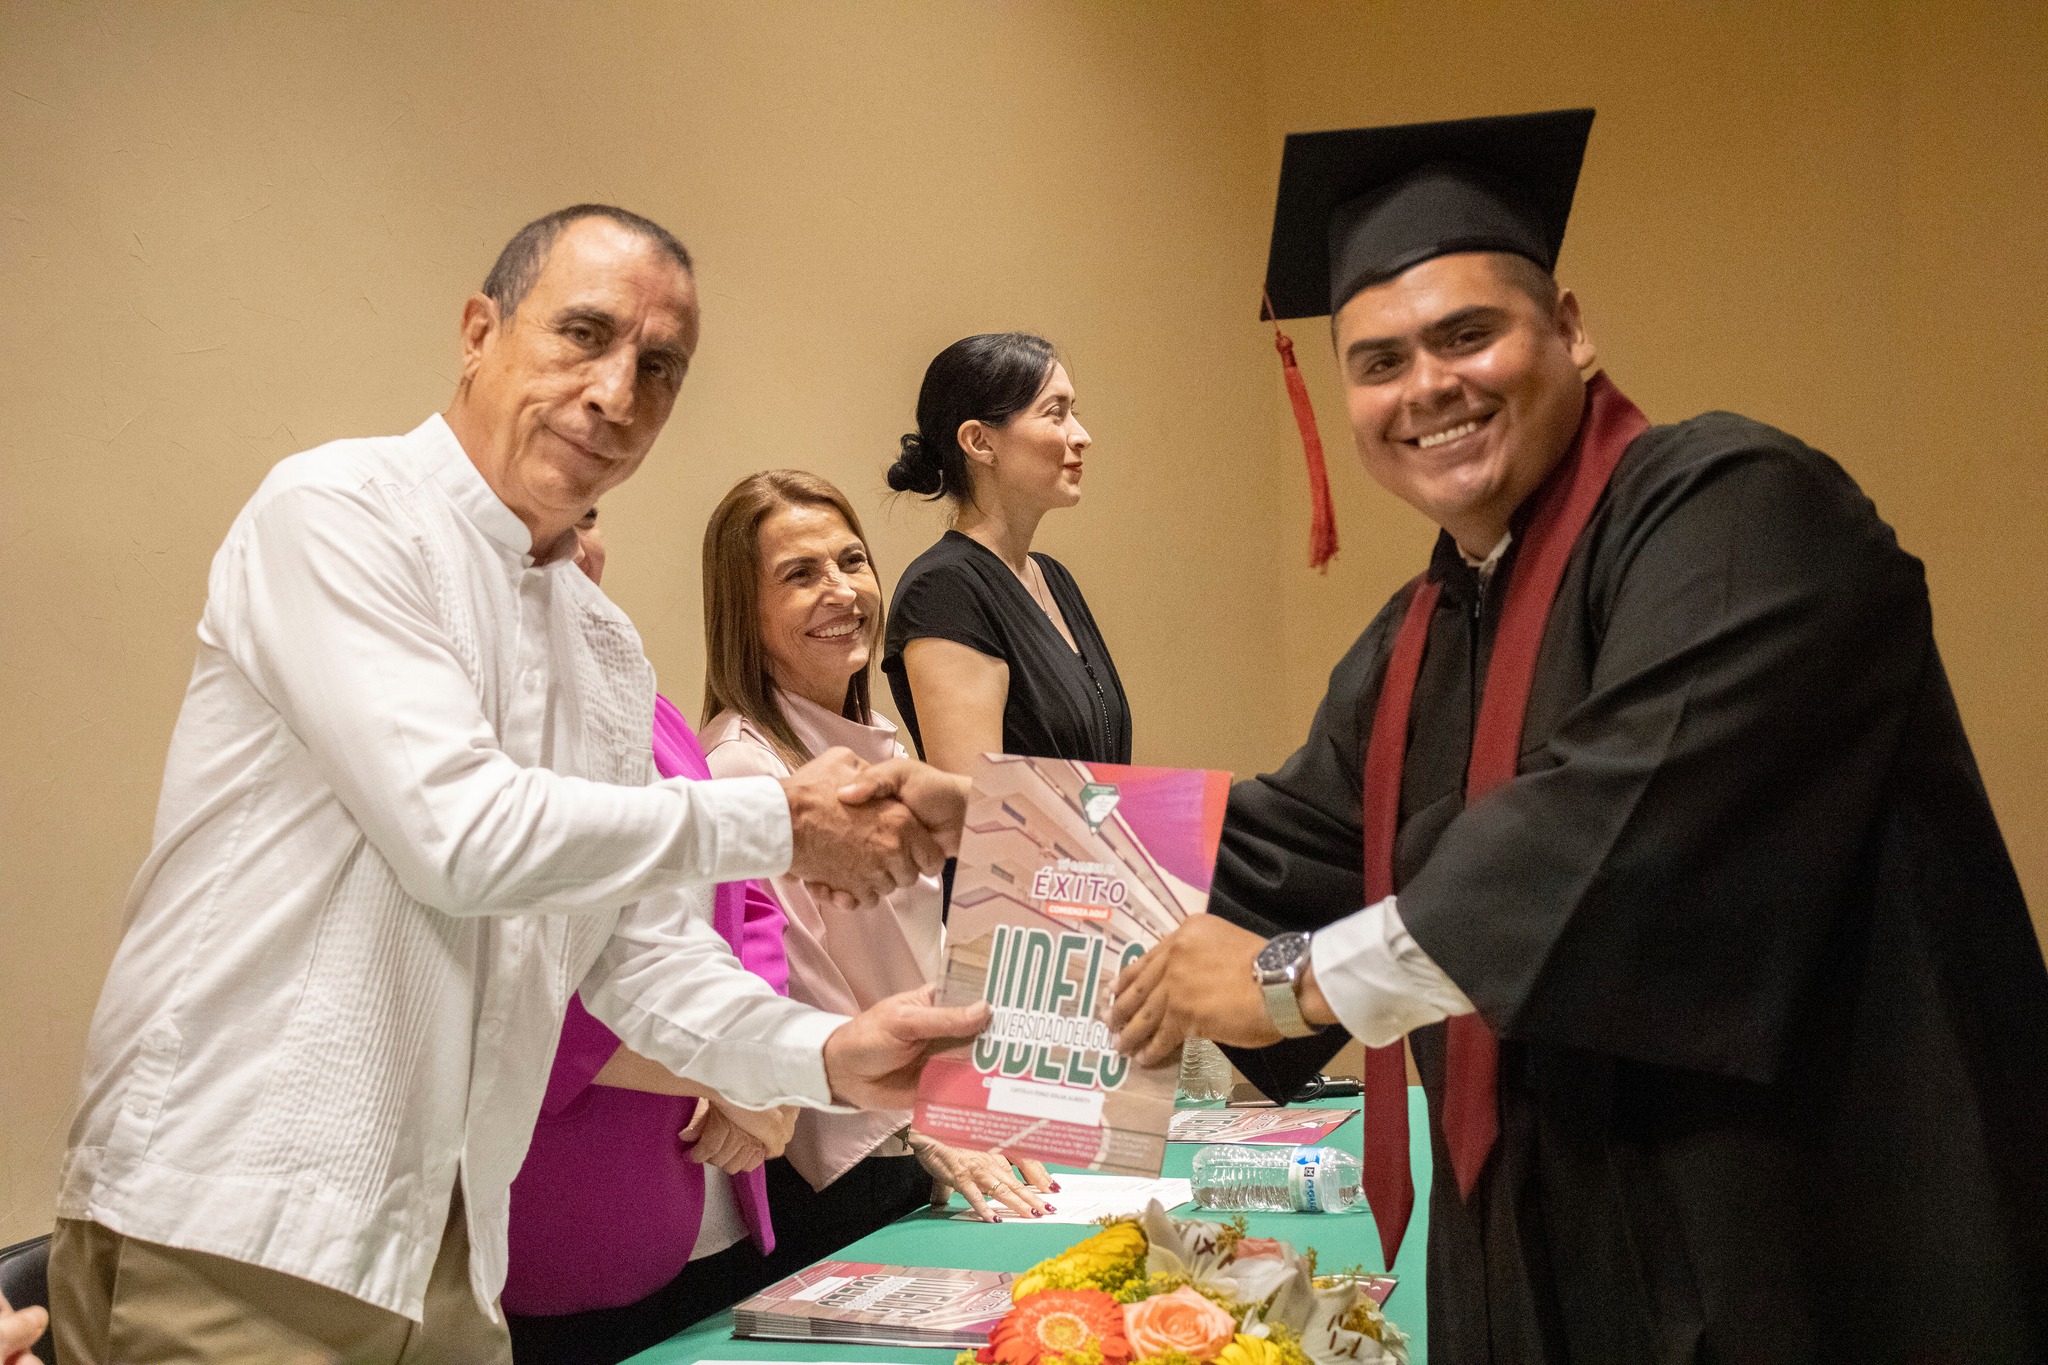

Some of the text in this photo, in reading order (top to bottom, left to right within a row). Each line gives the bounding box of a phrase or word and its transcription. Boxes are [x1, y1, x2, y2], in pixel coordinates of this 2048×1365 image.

[1033, 867, 1127, 905] ÉXITO
[987, 1009, 1064, 1043] NIVERSIDAD
[1064, 1019, 1088, 1047] DEL
